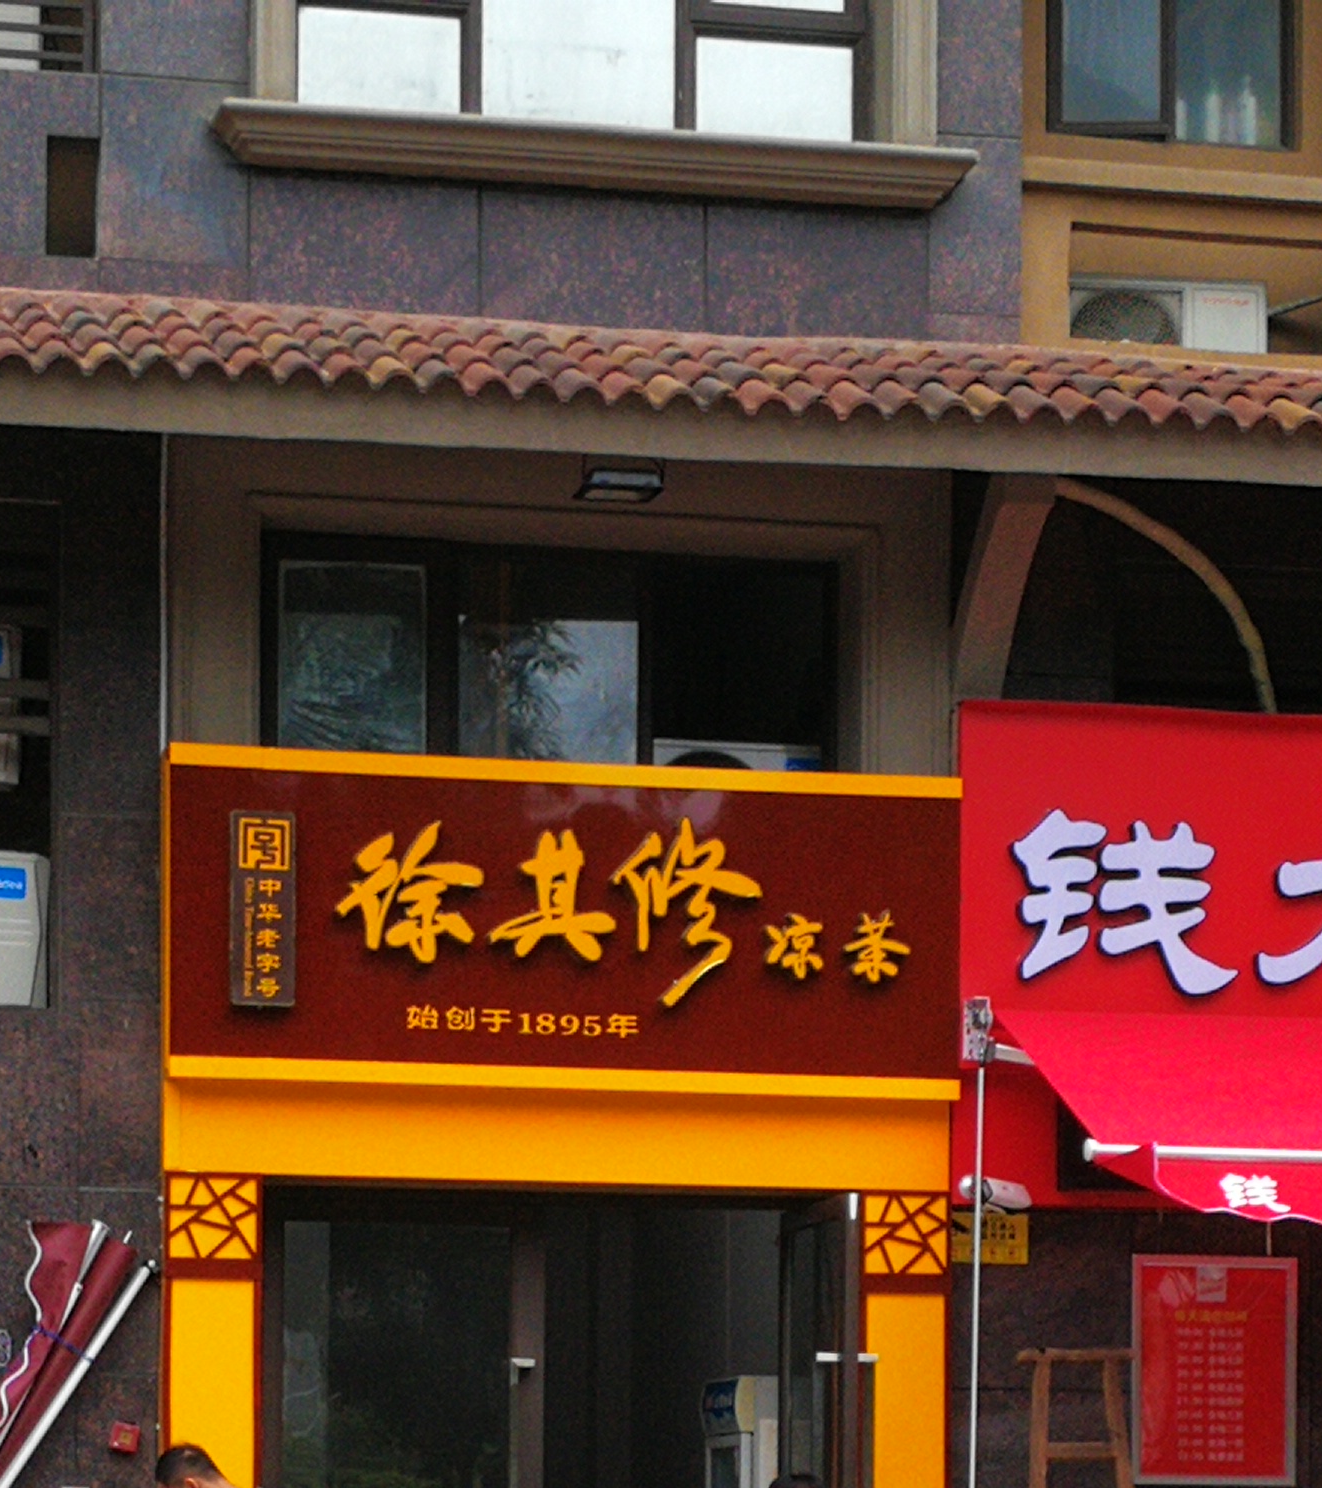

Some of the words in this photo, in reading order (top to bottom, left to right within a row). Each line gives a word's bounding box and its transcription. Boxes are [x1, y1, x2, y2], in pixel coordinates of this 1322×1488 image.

[256, 878, 282, 998] 中华老字号
[335, 816, 762, 1008] 徐其修
[762, 909, 911, 983] 凉茶
[406, 1005, 640, 1039] 始创于1895年
